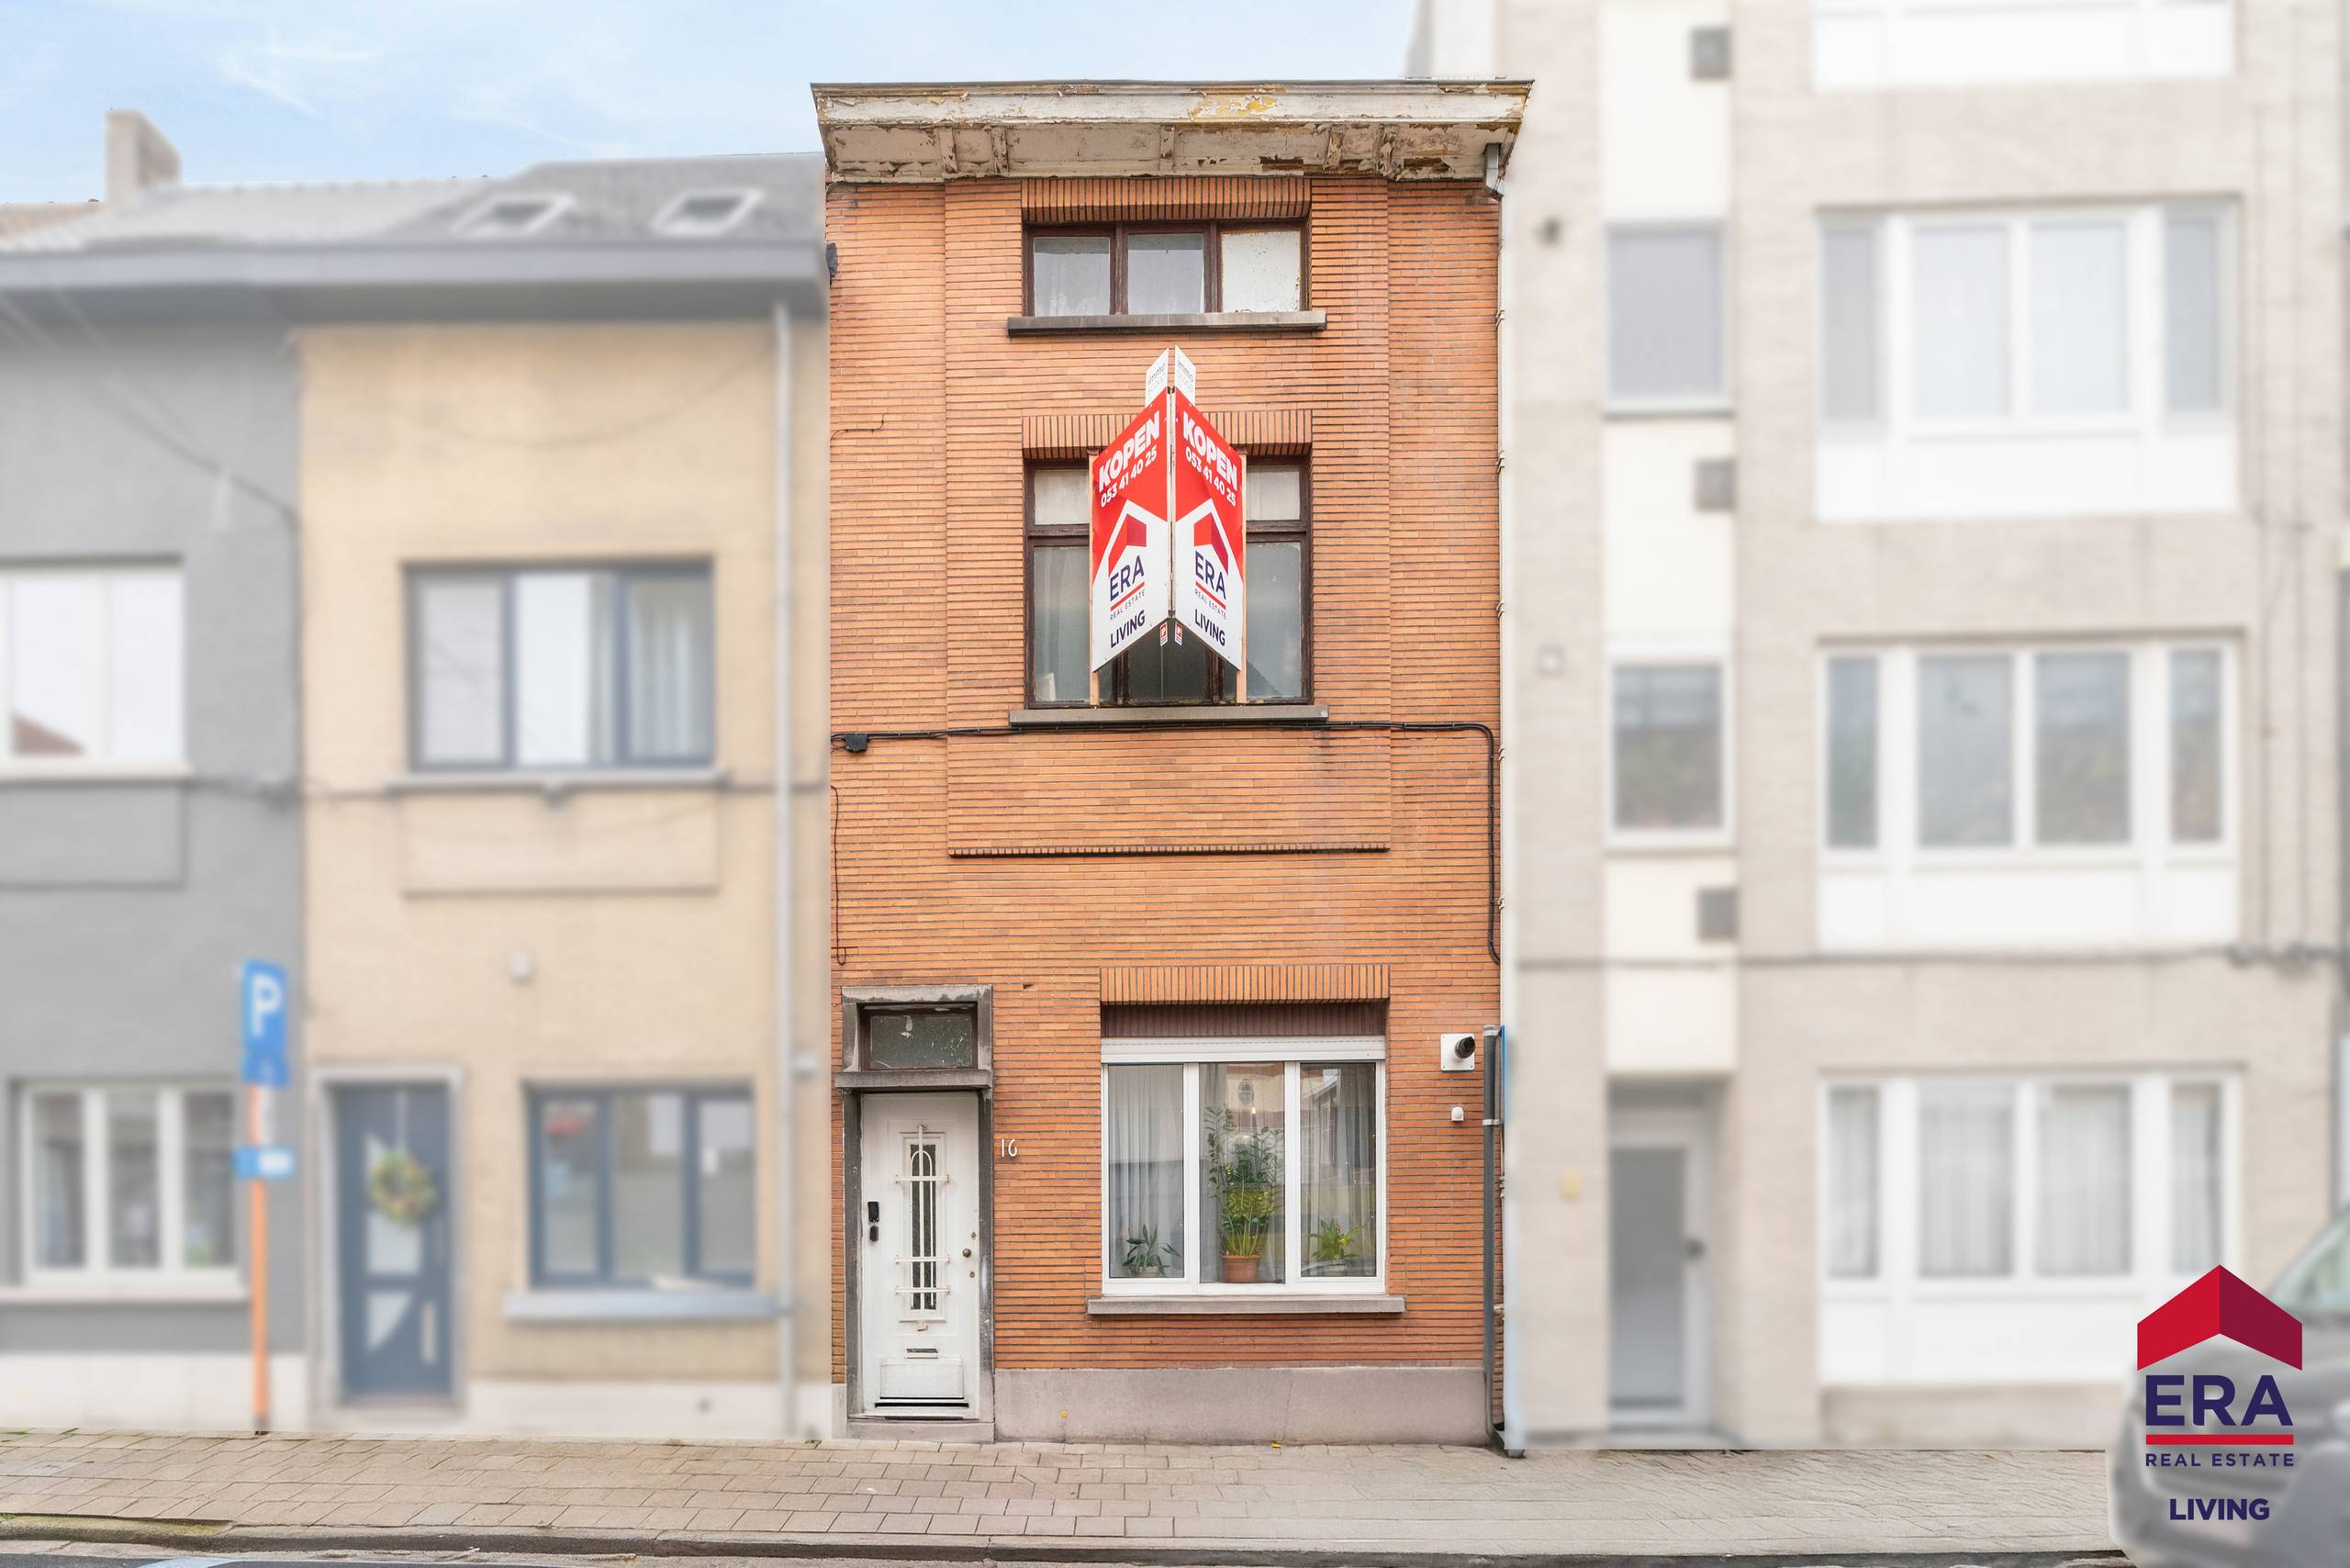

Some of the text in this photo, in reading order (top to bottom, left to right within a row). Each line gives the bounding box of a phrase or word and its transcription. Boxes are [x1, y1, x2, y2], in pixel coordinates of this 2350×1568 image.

[1098, 409, 1160, 494] KOPEN
[1182, 410, 1238, 492] KOPEN
[1101, 444, 1158, 508] 053 41 40 25
[1185, 446, 1237, 508] 053 41 40 25
[1109, 554, 1145, 602] ERA
[1194, 550, 1227, 600] ERA
[1109, 588, 1146, 622] REAL ESTATE
[1110, 609, 1146, 649] LIVING
[1193, 609, 1226, 647] LIVING
[1194, 588, 1227, 621] REAL ESTATE
[250, 970, 284, 1040] P
[1001, 1137, 1018, 1158] 16
